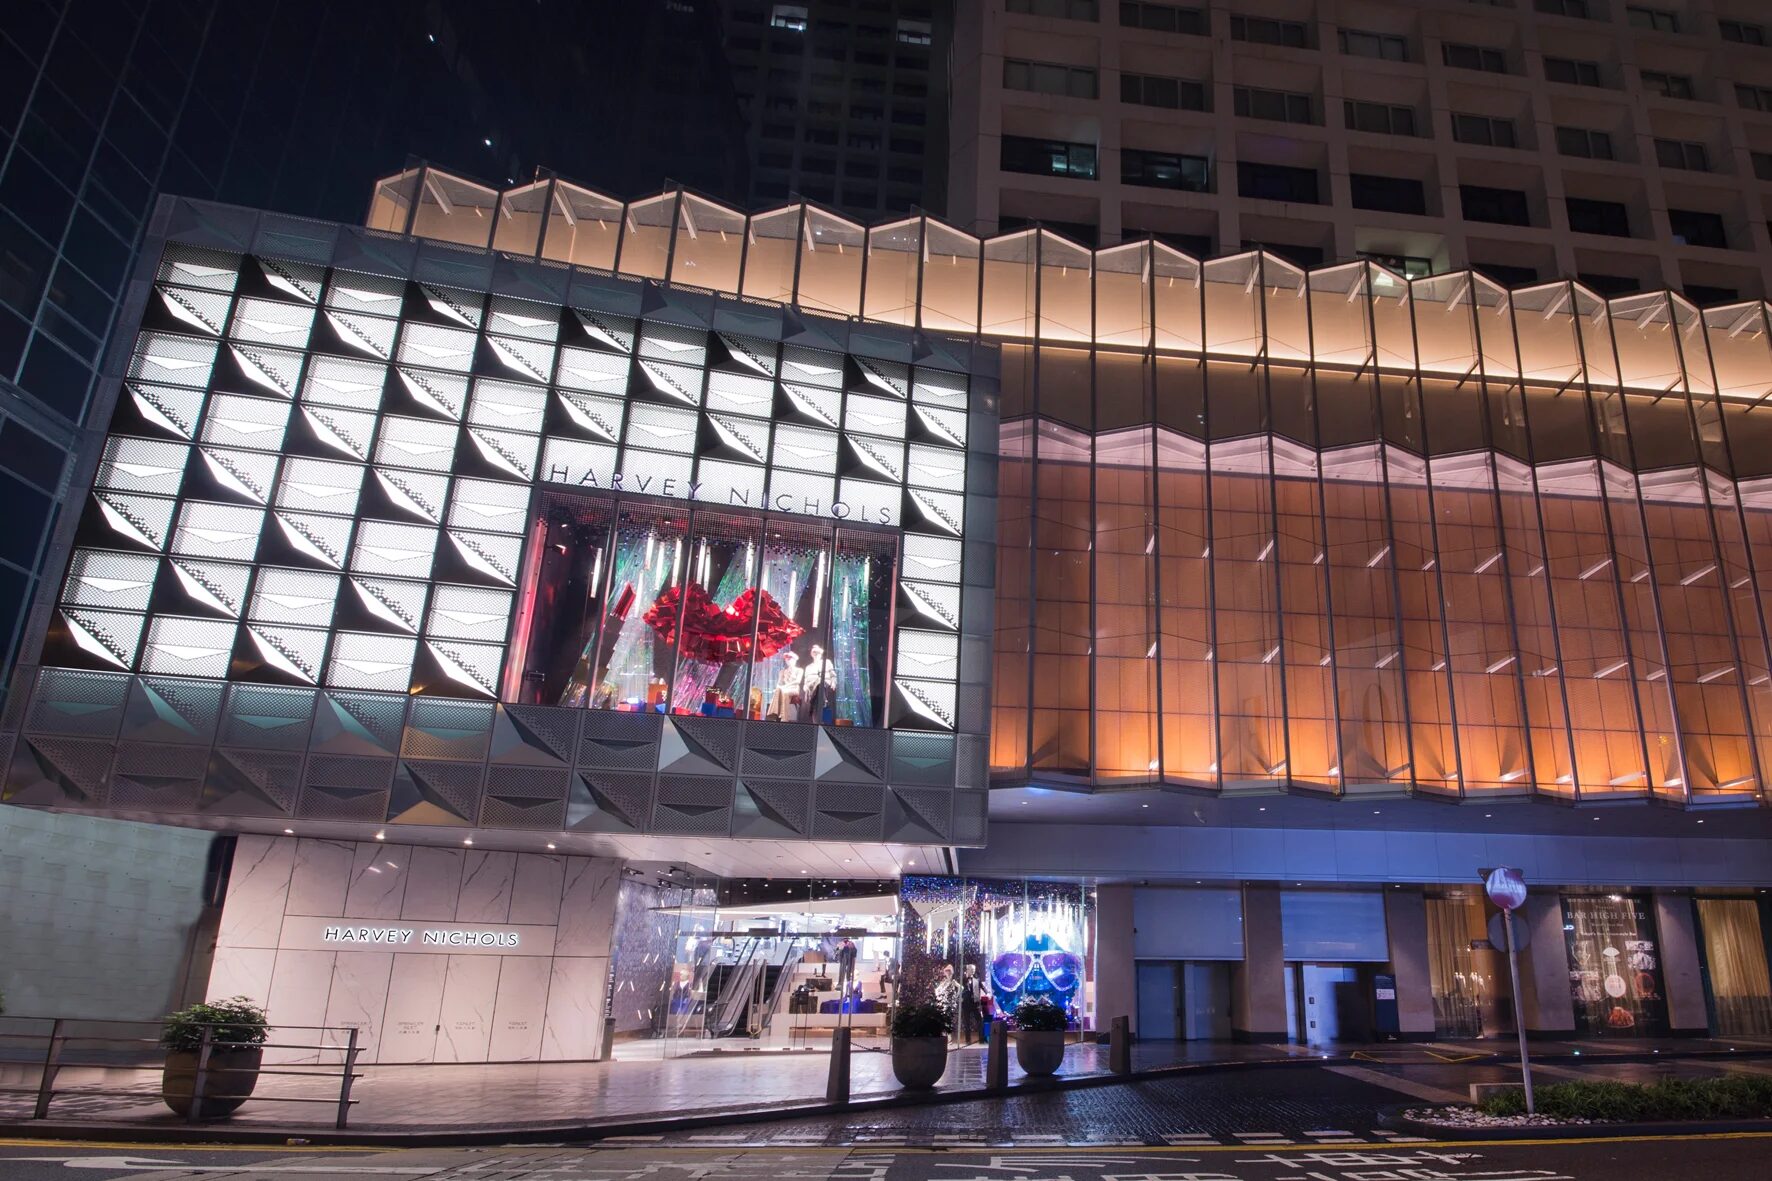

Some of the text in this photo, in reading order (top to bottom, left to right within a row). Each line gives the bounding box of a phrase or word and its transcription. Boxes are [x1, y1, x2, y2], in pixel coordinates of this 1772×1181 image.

[550, 464, 892, 524] HARVEY NICHOLS
[1567, 911, 1587, 919] BAR
[325, 928, 518, 946] HARVEY NICHOLS
